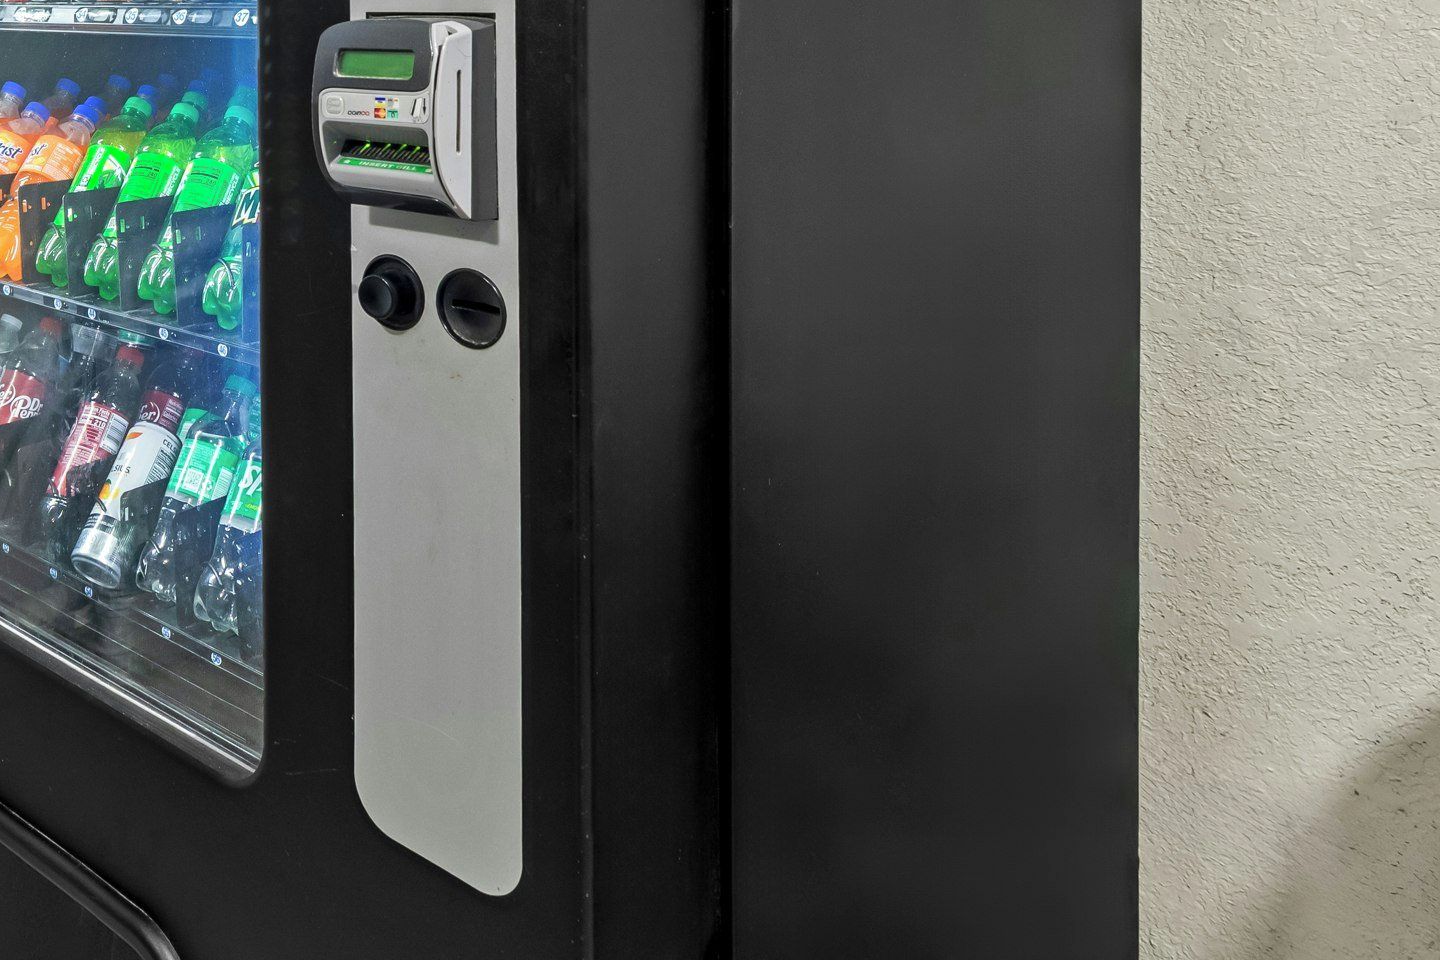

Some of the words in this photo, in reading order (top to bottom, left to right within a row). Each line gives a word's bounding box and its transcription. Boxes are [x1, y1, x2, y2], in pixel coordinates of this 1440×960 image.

[126, 10, 137, 22] 35
[174, 11, 186, 23] 36
[235, 11, 248, 24] 37
[359, 161, 394, 169] INSERT
[94, 419, 106, 428] 210
[211, 653, 221, 664] 56
